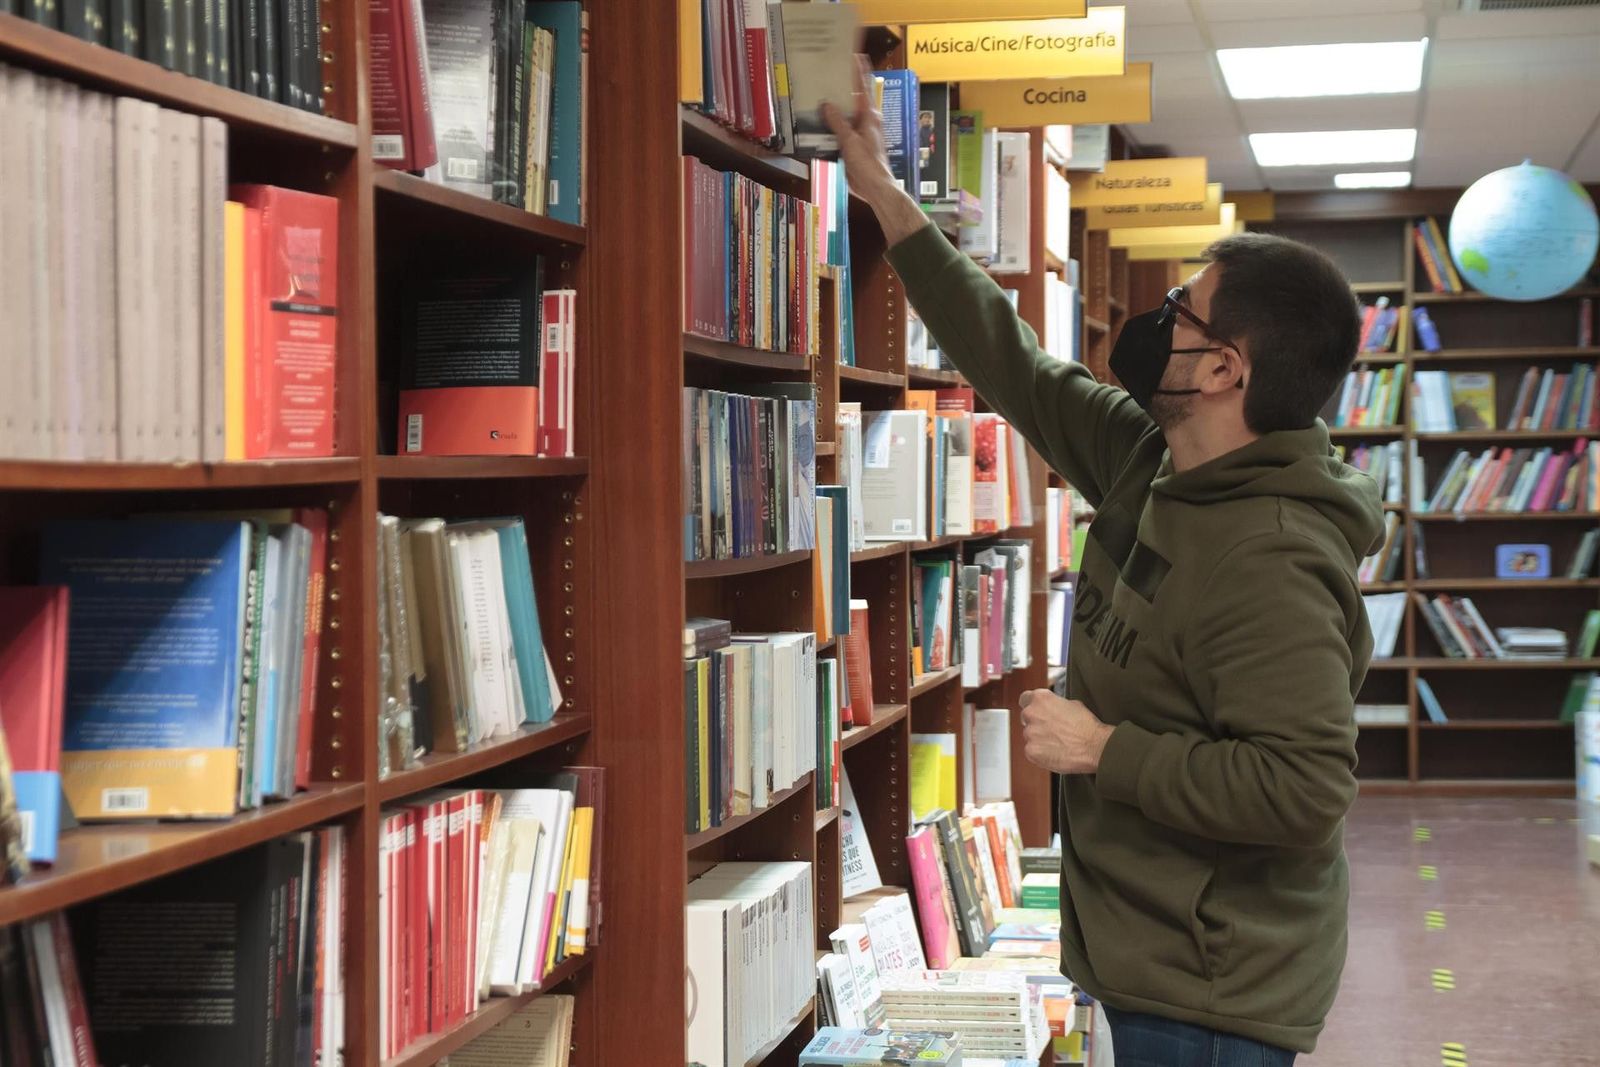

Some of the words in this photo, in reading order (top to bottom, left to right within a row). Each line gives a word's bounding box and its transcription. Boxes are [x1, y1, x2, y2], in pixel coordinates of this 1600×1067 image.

[914, 32, 1116, 54] Música/Cine/Fotografía
[1023, 86, 1087, 105] Cocina
[1096, 176, 1172, 190] Naturaleza
